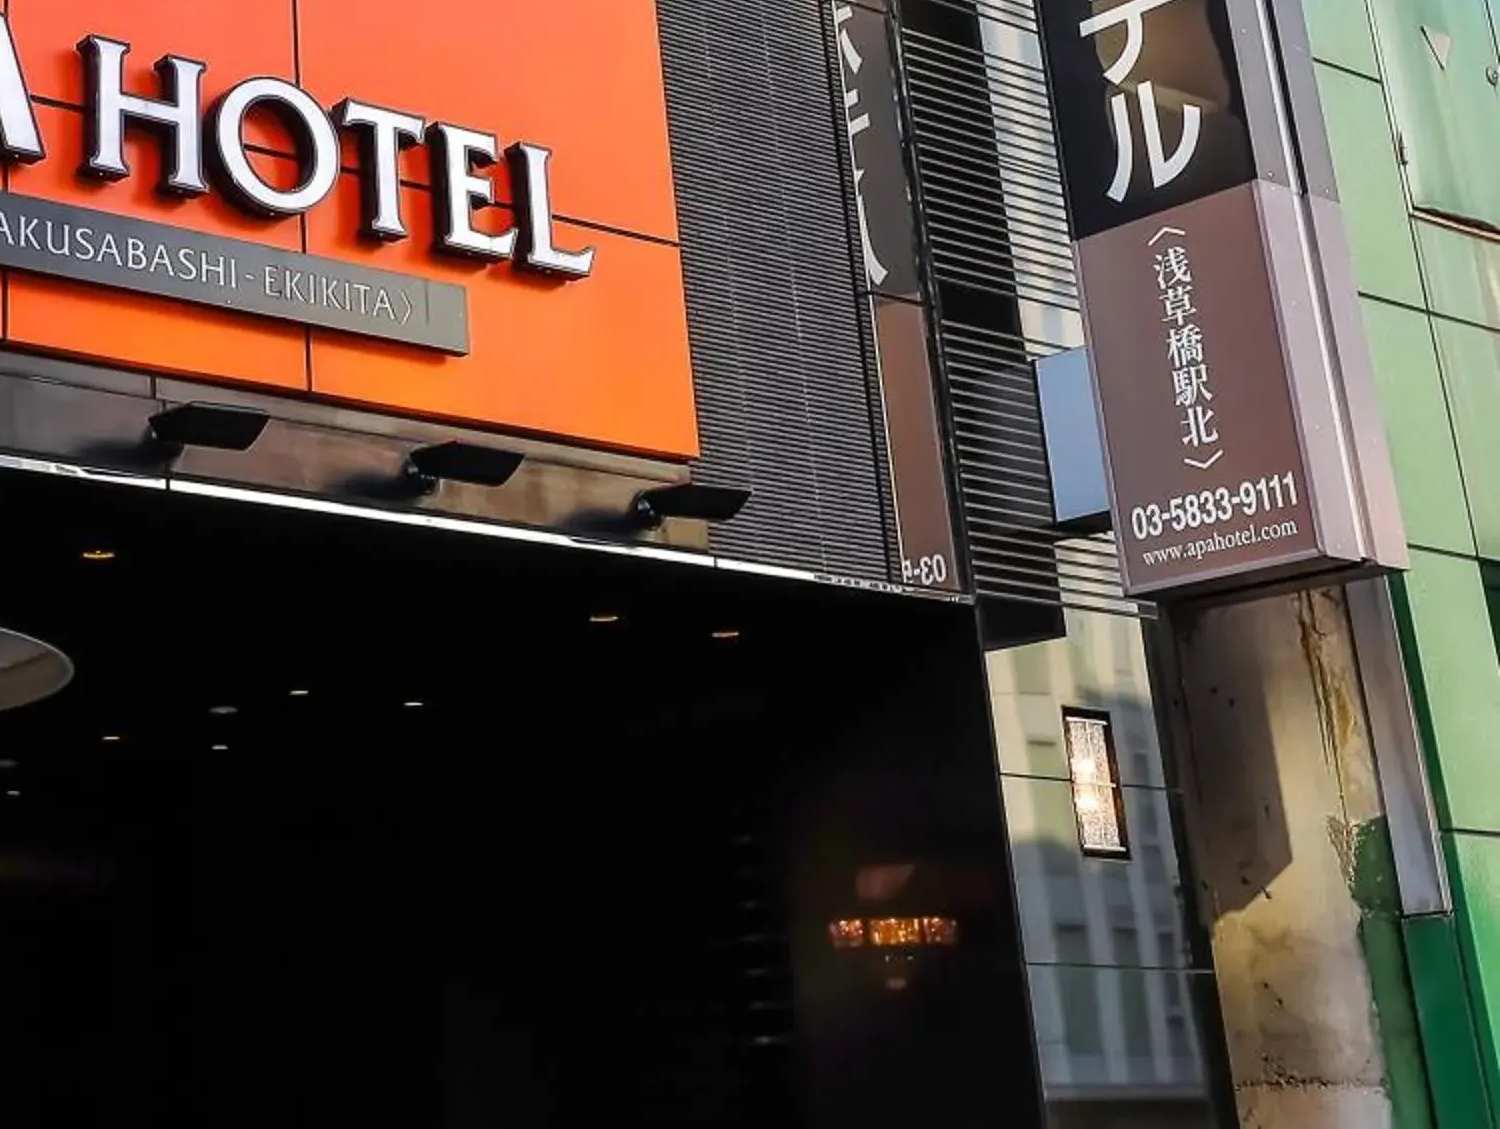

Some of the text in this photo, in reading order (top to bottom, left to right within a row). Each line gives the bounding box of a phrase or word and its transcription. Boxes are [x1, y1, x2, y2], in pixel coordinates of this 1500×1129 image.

[77, 33, 597, 280] HOTEL
[1131, 470, 1299, 541] 03-5833-9111
[1142, 518, 1299, 567] www.apahotel.com
